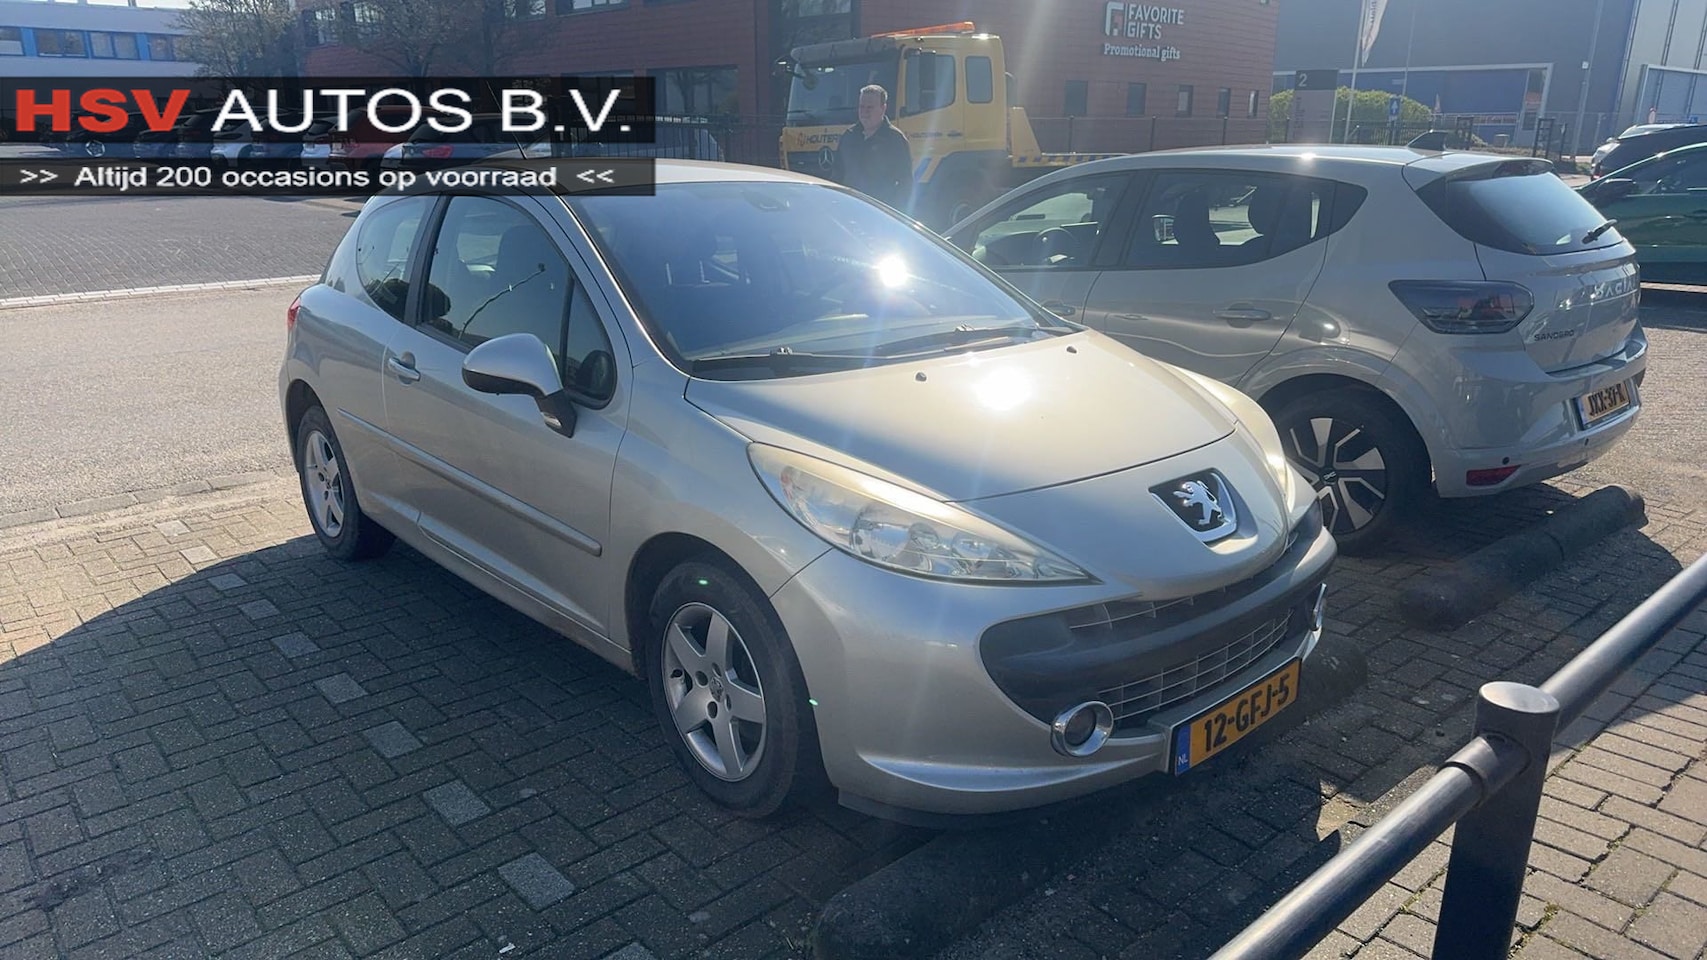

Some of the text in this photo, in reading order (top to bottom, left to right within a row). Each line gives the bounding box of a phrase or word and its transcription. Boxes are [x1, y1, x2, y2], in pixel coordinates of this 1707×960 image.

[1128, 3, 1184, 26] FAVORITE
[1127, 21, 1162, 40] GIFTS
[1103, 42, 1181, 62] Promotional gifts
[1298, 73, 1308, 87] 2
[806, 132, 841, 145] HOUTER
[1533, 329, 1575, 342] SANDERO
[1177, 672, 1291, 766] NL 12-GFJ-5
